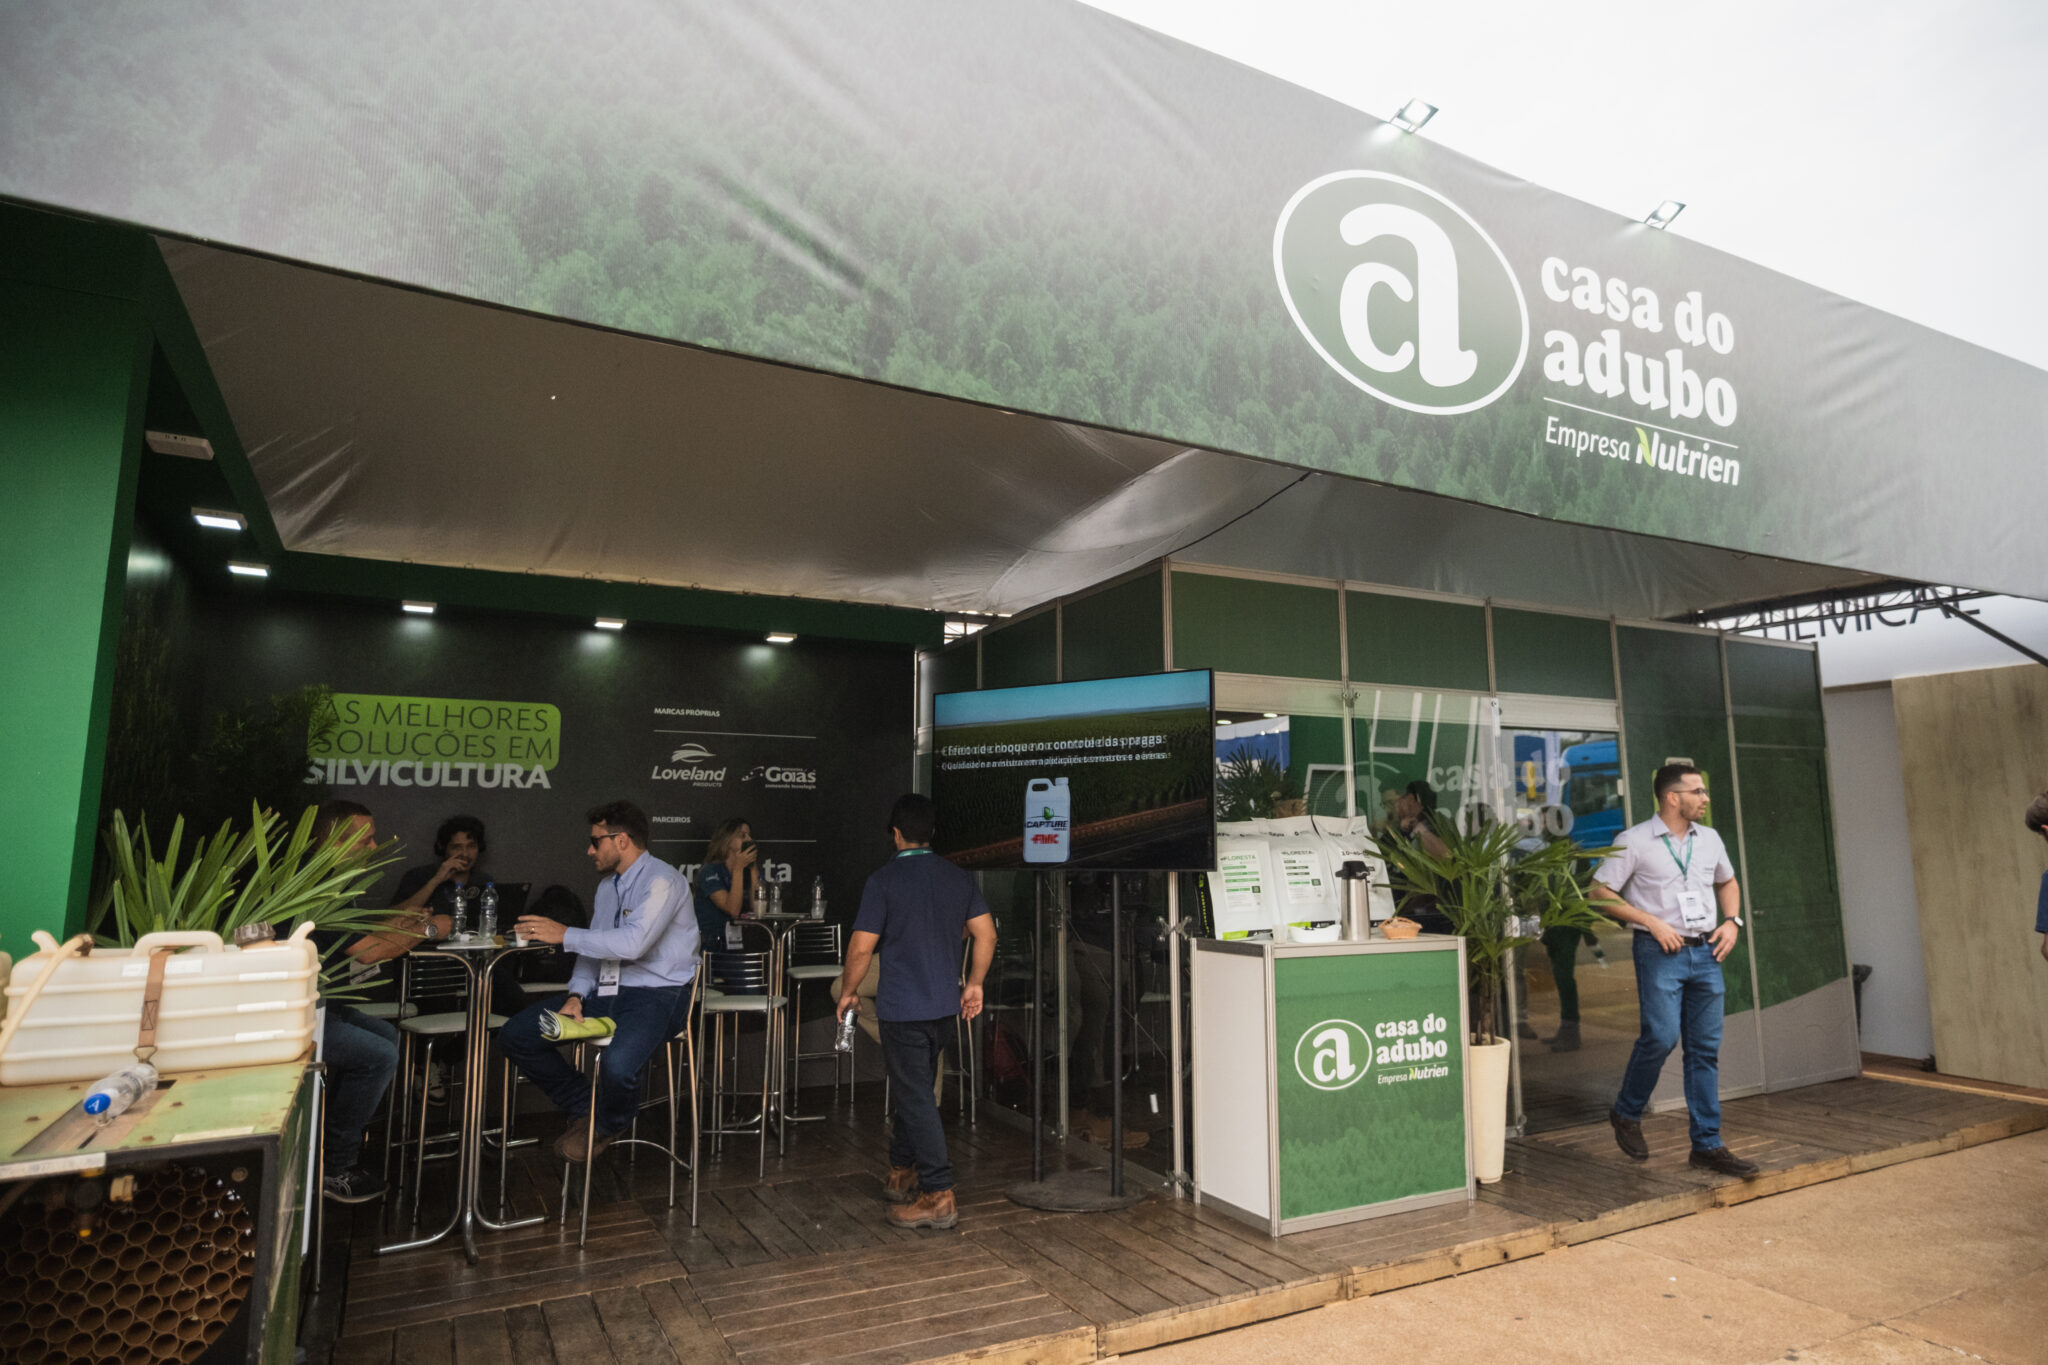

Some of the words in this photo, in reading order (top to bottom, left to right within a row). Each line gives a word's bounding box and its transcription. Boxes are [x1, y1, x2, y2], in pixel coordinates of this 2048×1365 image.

[1540, 256, 1662, 334] casa
[1674, 290, 1735, 356] do
[1542, 328, 1739, 428] adubo
[1545, 415, 1631, 463] Empresa
[1635, 425, 1741, 487] Nutrien
[373, 702, 549, 732] MELHORES
[654, 707, 685, 716] MARCAS
[685, 708, 721, 717] PRÓPRIAS
[315, 728, 497, 762] SOLUÇÕES
[509, 736, 553, 760] EM
[303, 757, 552, 789] SILVICULTURA
[651, 765, 727, 782] Loveland
[652, 816, 692, 824] PARCEIROS
[1375, 1019, 1418, 1039] casa
[1422, 1012, 1447, 1034] do
[1375, 1035, 1448, 1065] adubo
[1377, 1072, 1408, 1086] Empresa
[1408, 1063, 1449, 1081] Nutrien
